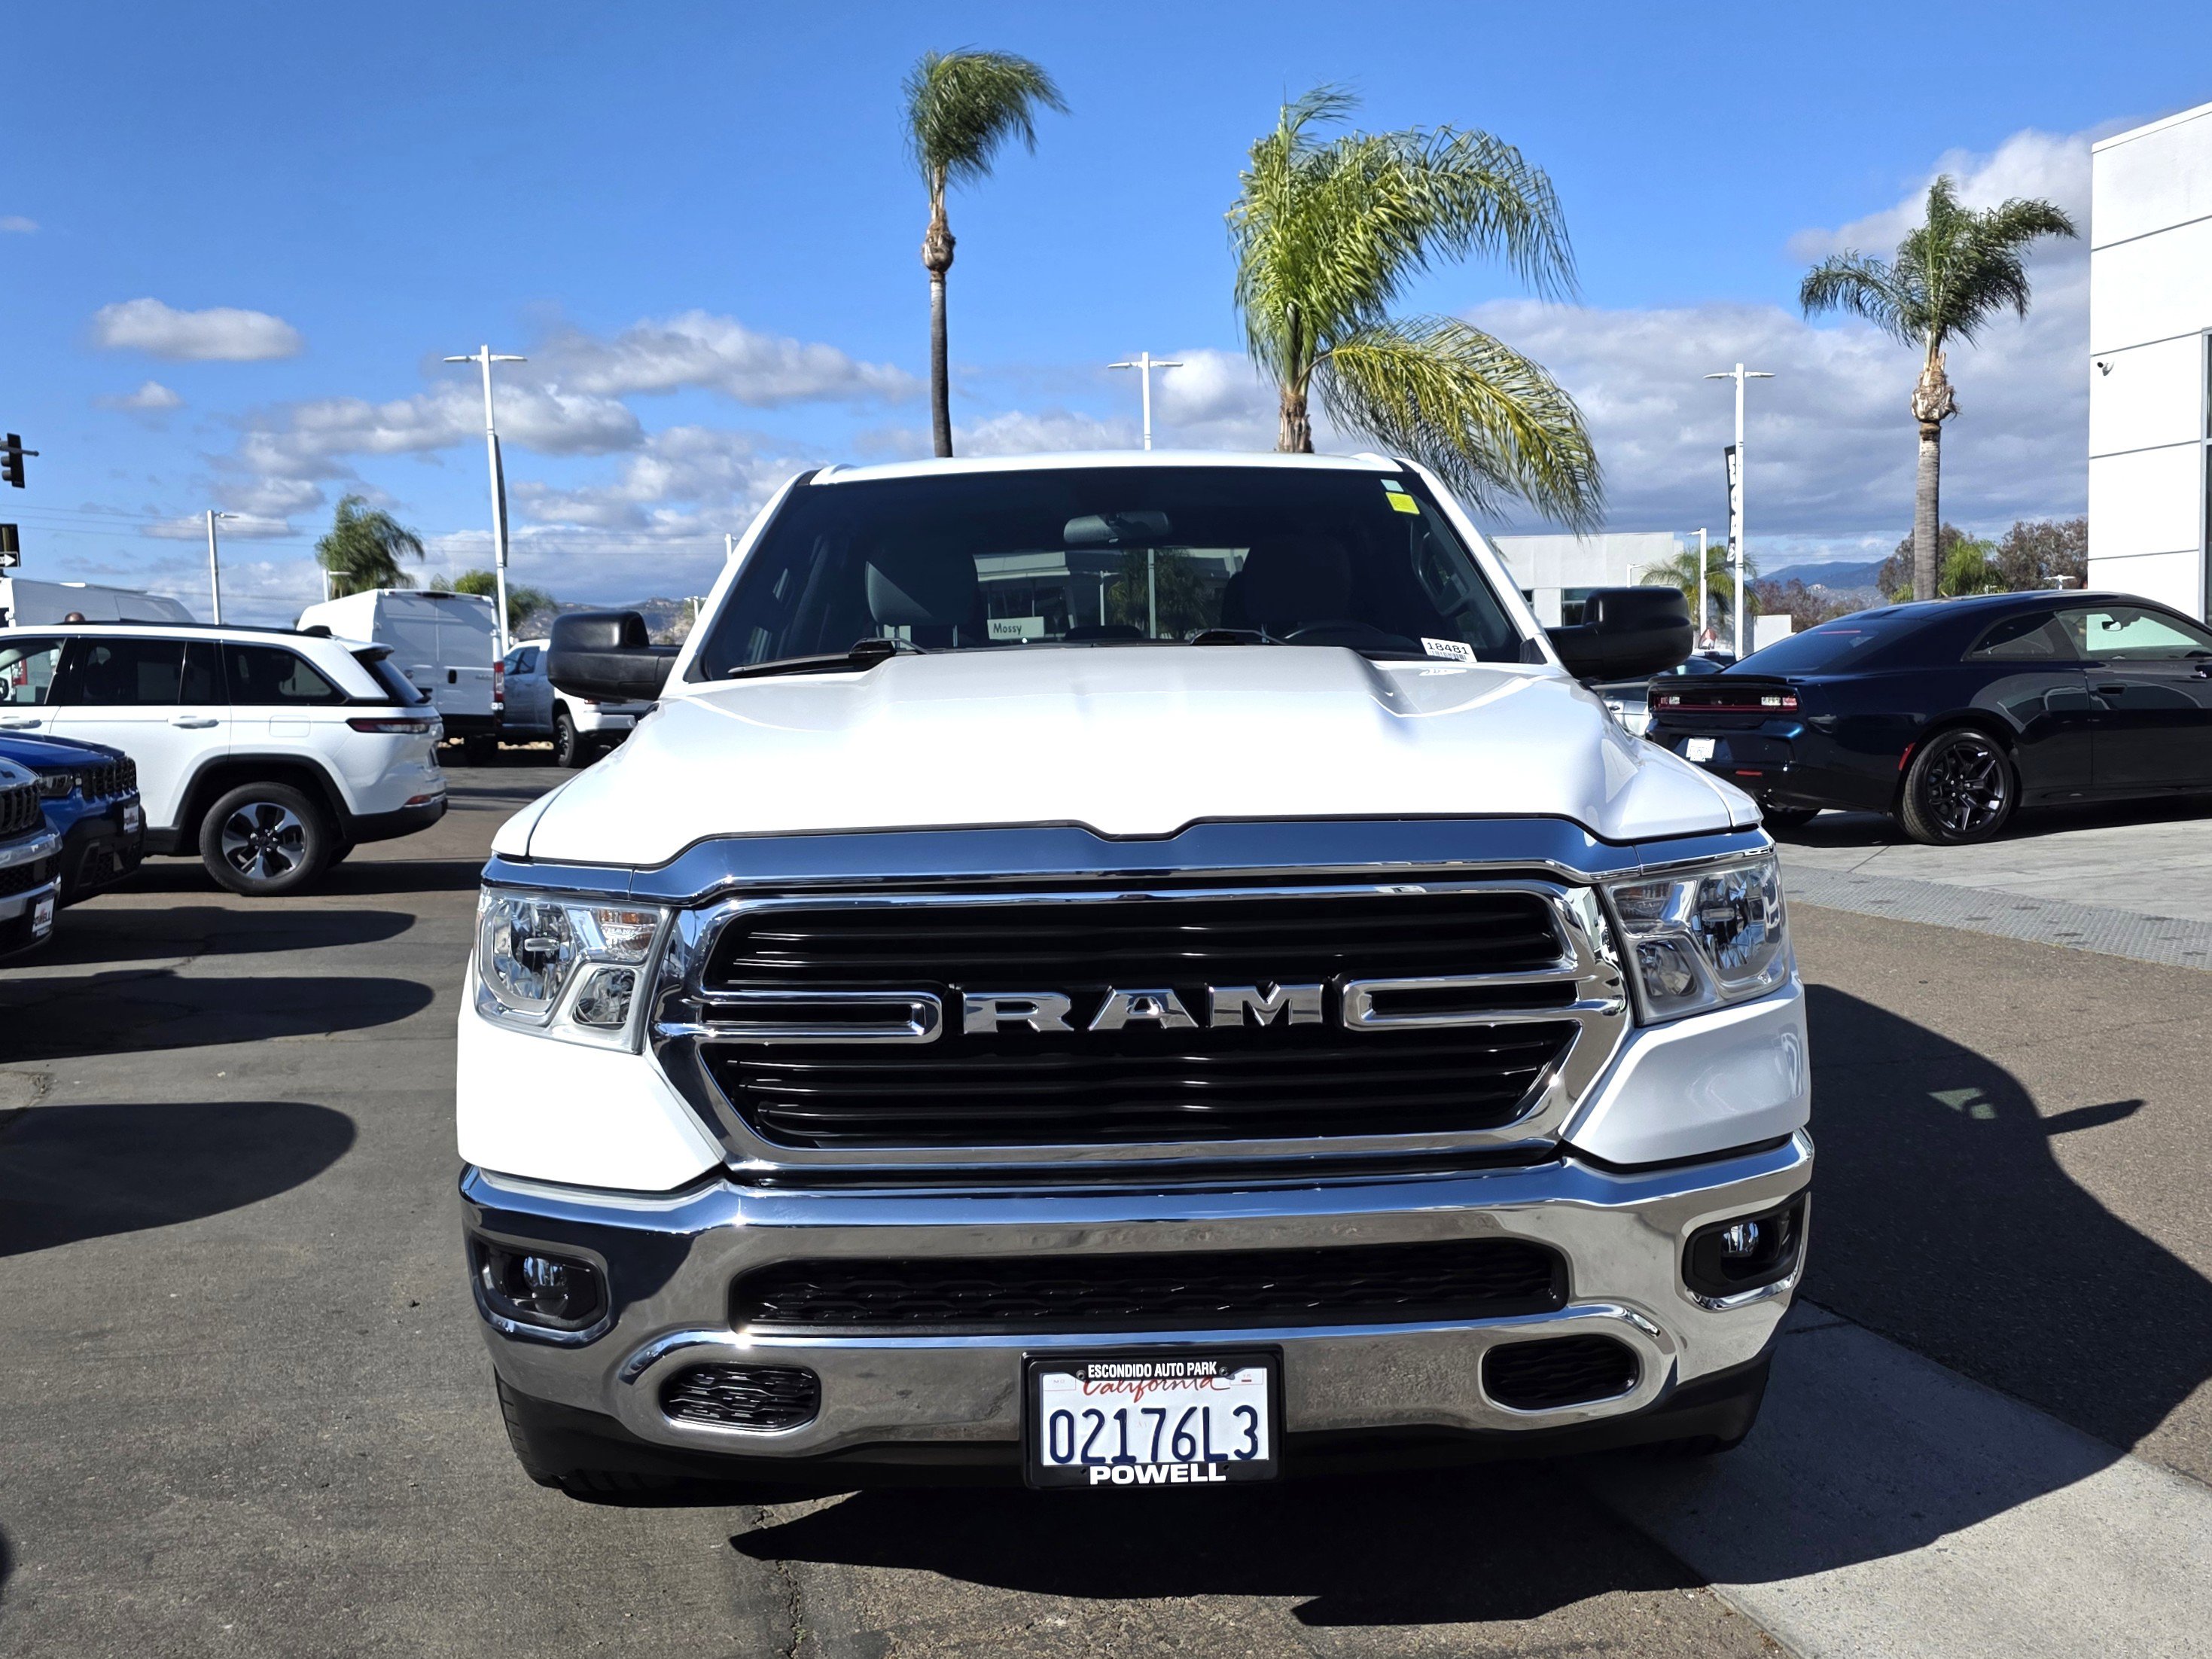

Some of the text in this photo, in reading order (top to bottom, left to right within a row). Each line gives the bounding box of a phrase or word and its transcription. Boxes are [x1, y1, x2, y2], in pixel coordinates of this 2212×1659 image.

[993, 622, 1022, 635] Mossy
[1427, 642, 1470, 655] 18481
[962, 982, 1324, 1034] RAM
[1088, 1361, 1217, 1378] ESCONDIDO AUTO PARK
[1083, 1376, 1231, 1403] California
[1049, 1404, 1258, 1464] 02176L3
[1089, 1462, 1226, 1485] POWELL
